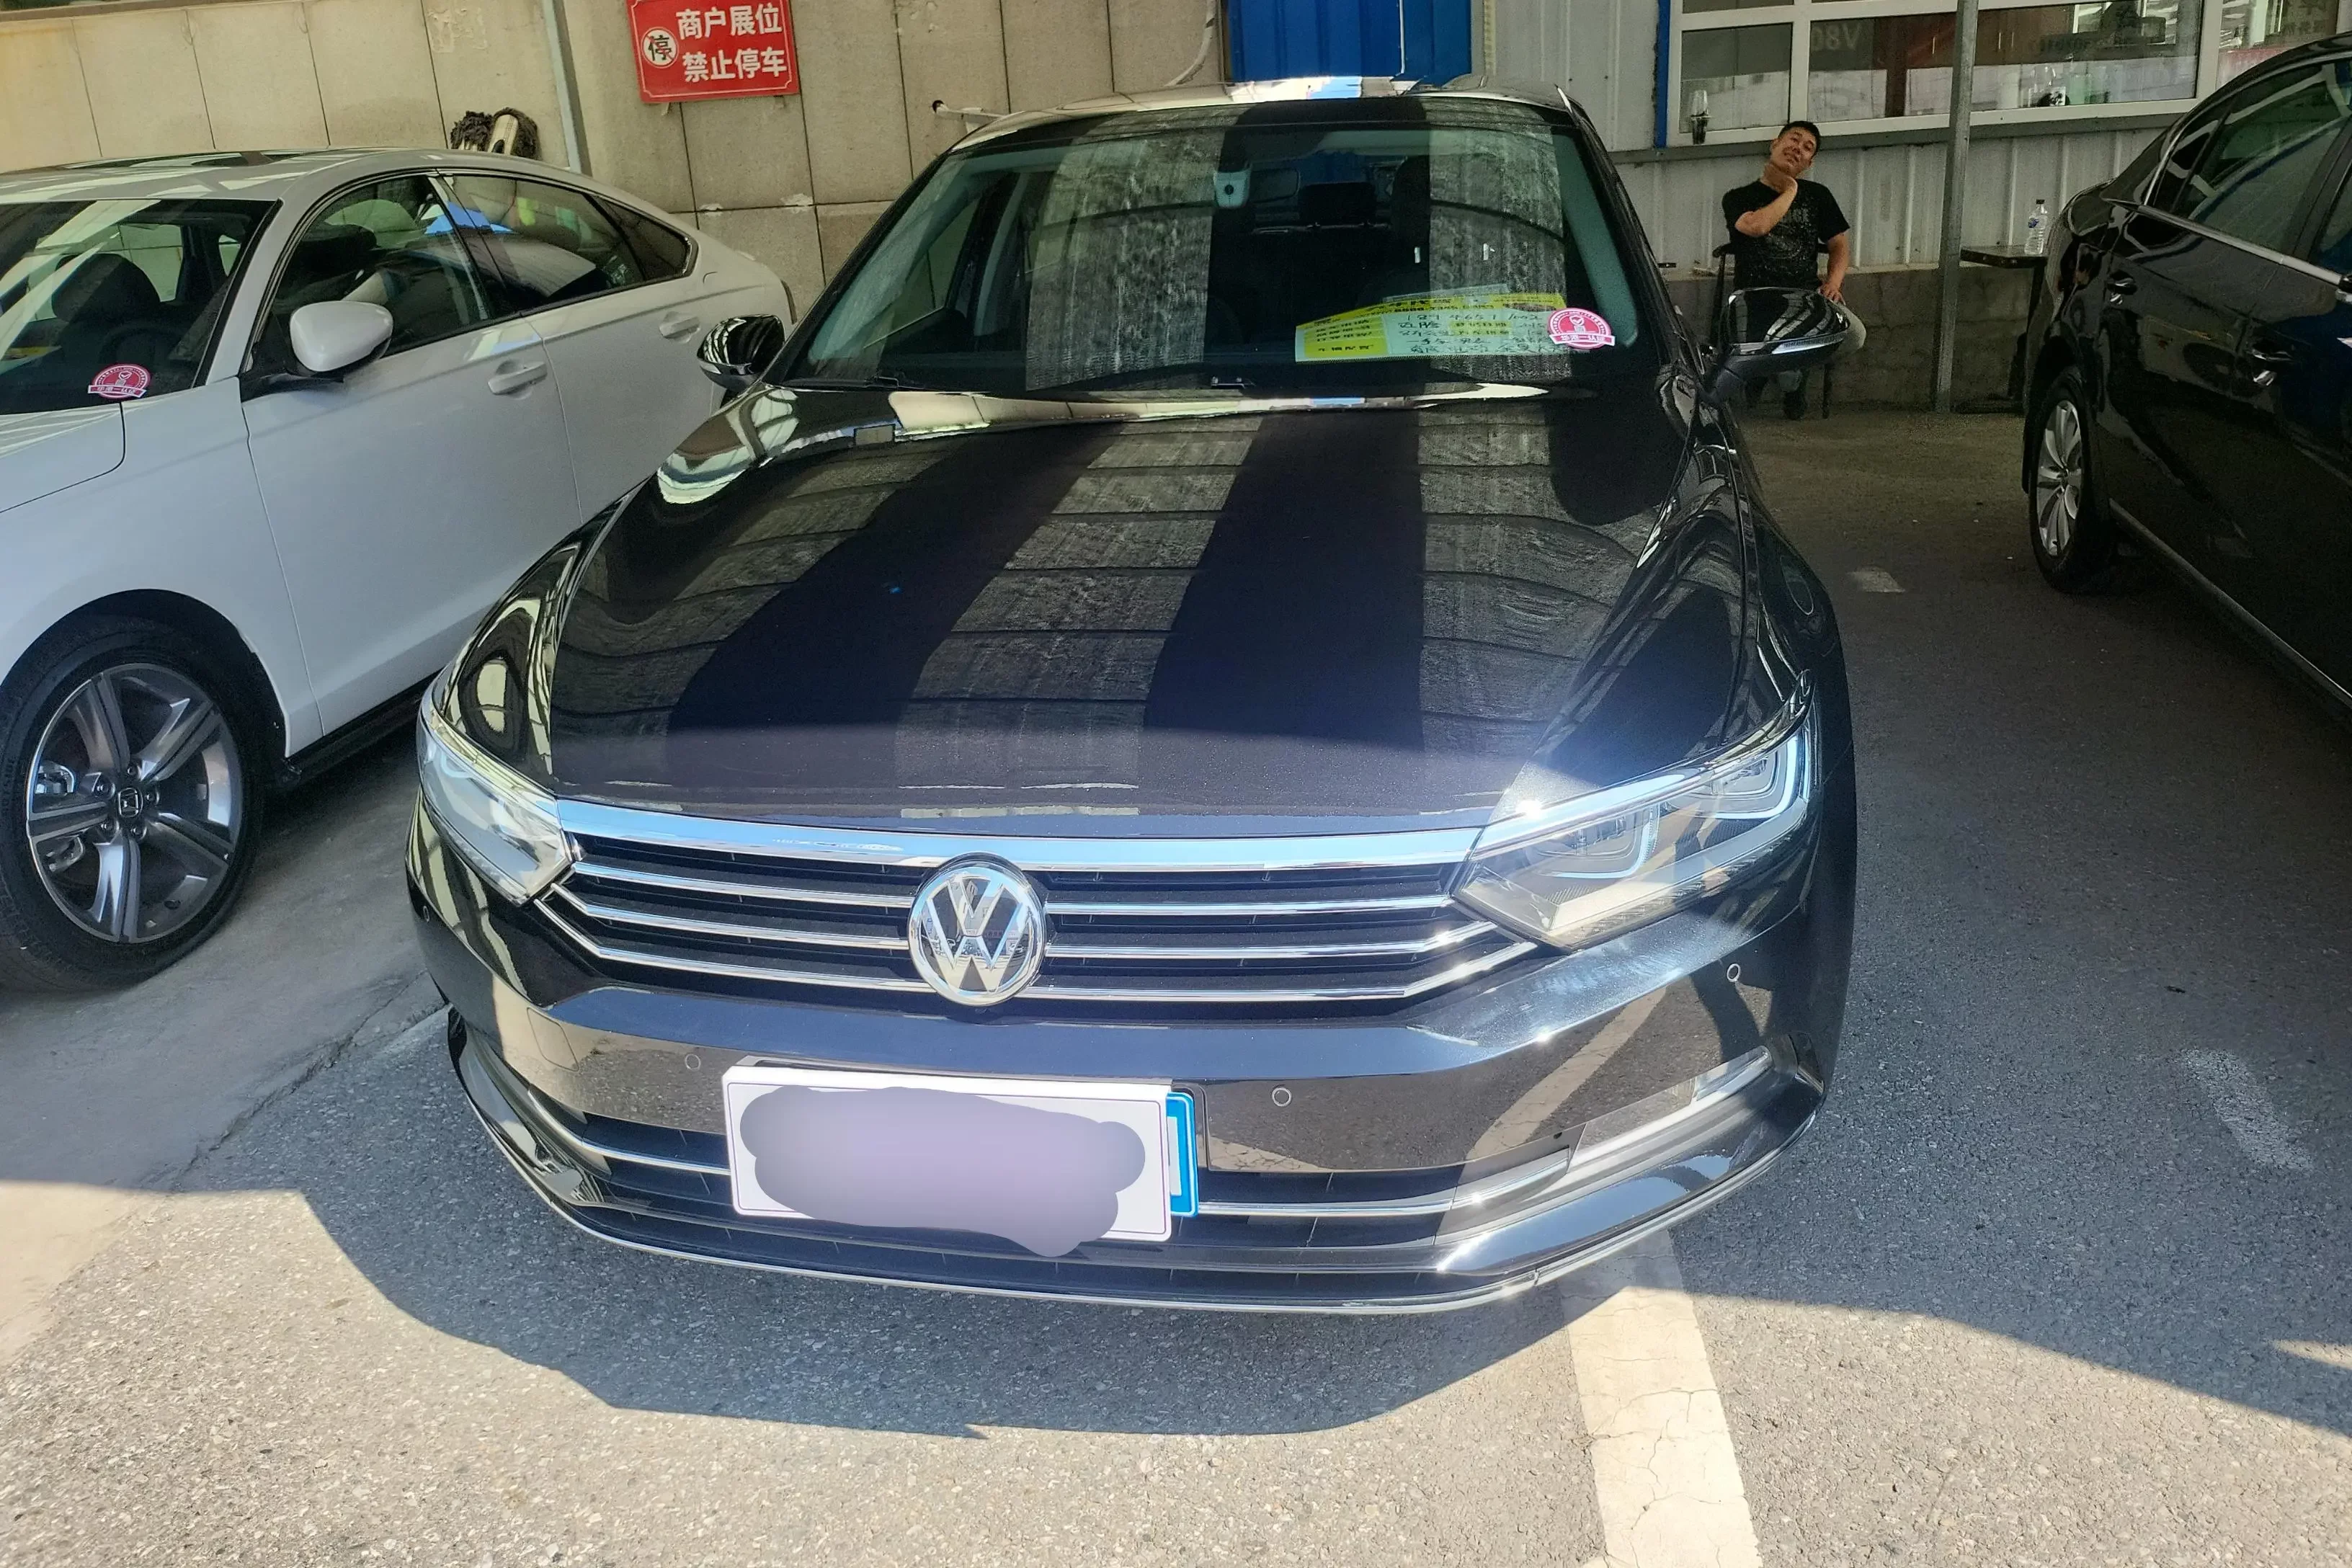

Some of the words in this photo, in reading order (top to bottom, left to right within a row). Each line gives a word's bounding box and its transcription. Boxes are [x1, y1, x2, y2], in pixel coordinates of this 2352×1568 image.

[676, 4, 783, 40] 商户展位
[648, 35, 672, 61] 停
[682, 46, 788, 83] 禁止停车
